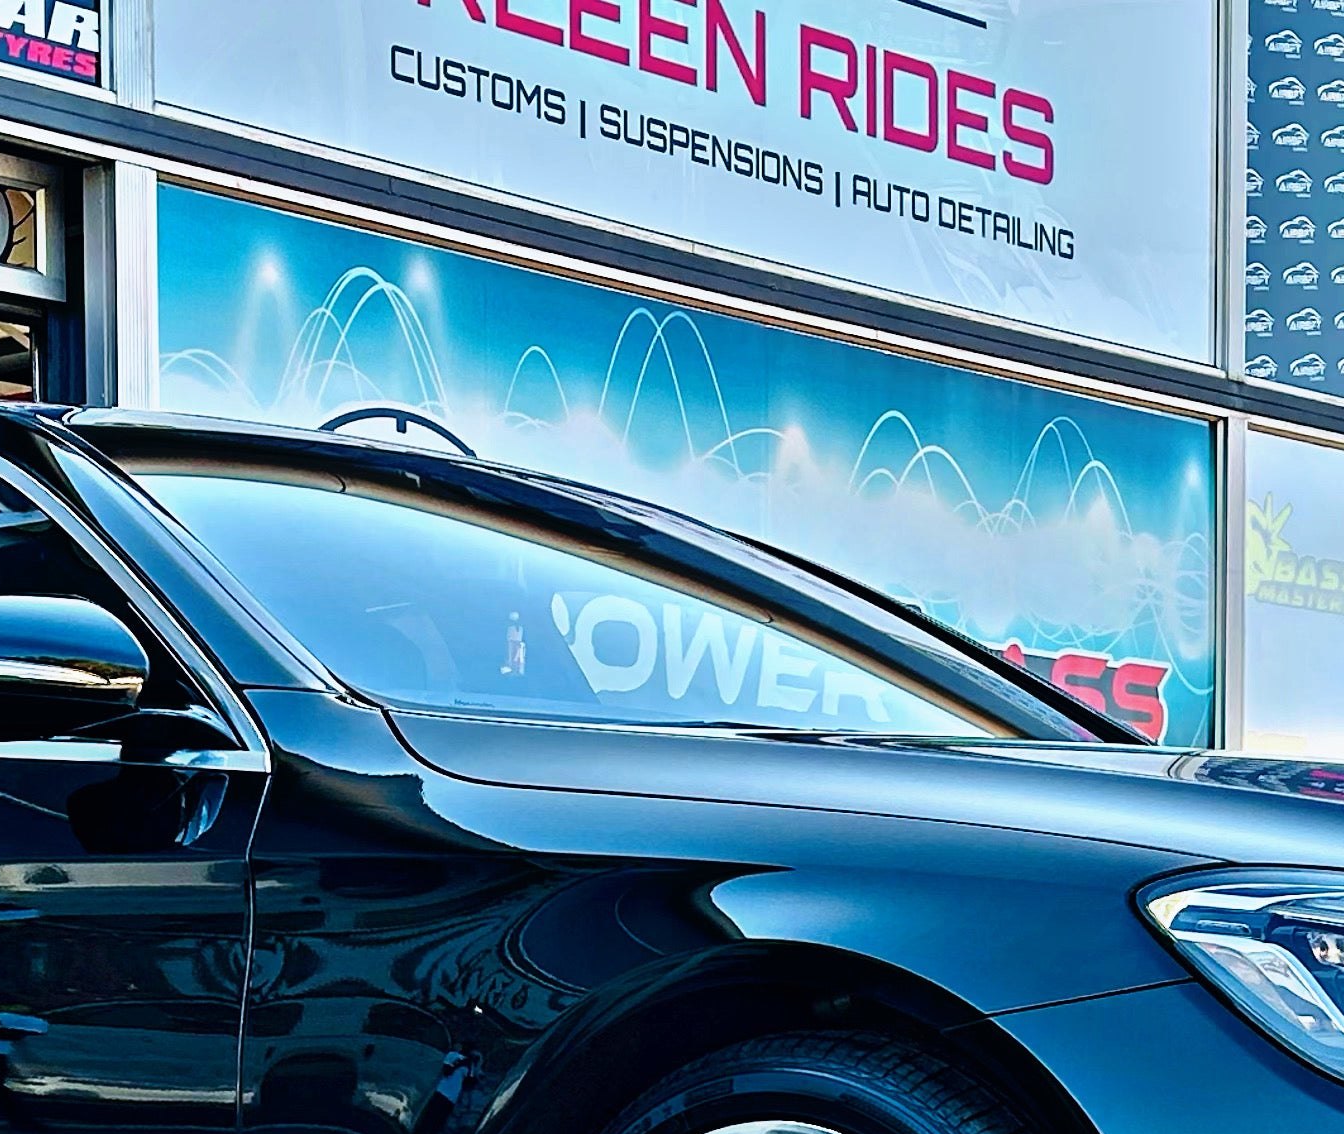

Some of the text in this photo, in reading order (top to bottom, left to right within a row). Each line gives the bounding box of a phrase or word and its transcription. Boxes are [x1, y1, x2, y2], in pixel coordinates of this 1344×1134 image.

[391, 45, 565, 124] CUSTOMS
[600, 104, 823, 195] SUSPENSIONS
[853, 175, 930, 223] AUTO
[939, 197, 1074, 260] DETAILING
[417, 0, 1054, 186] LEEN RIDES
[551, 594, 891, 723] OWER
